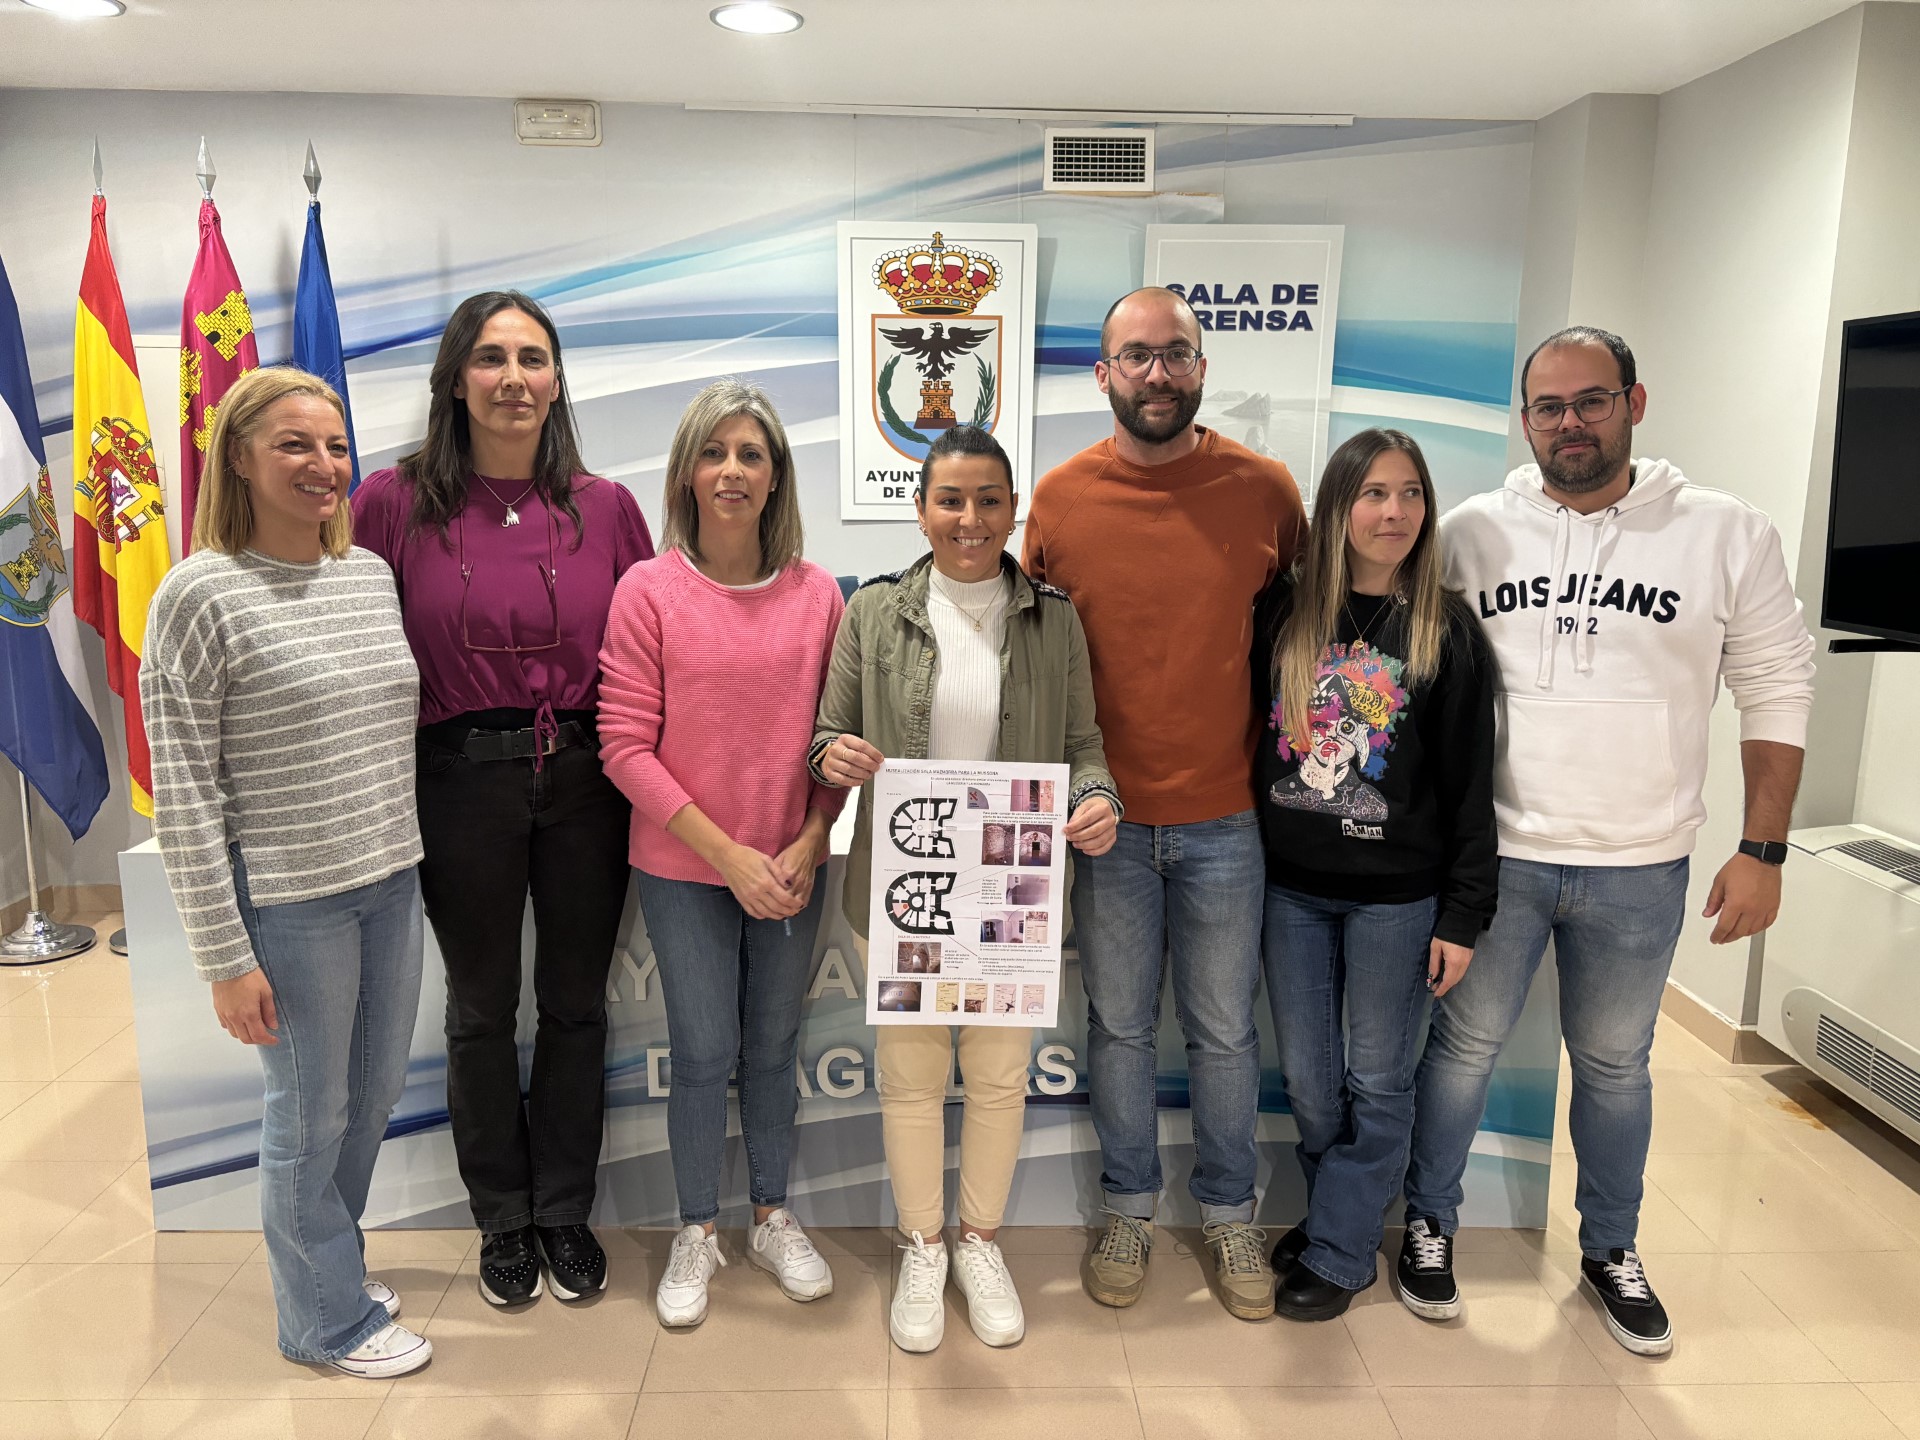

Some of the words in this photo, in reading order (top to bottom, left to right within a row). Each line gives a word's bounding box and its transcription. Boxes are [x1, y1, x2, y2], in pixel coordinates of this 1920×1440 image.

[1271, 284, 1319, 305] DE
[1194, 310, 1314, 331] RENSA
[865, 470, 922, 483] AYUNT
[883, 486, 906, 498] DE
[1479, 575, 1551, 619] LOIS
[1556, 573, 1681, 624] JEANS
[1556, 616, 1598, 635] 192
